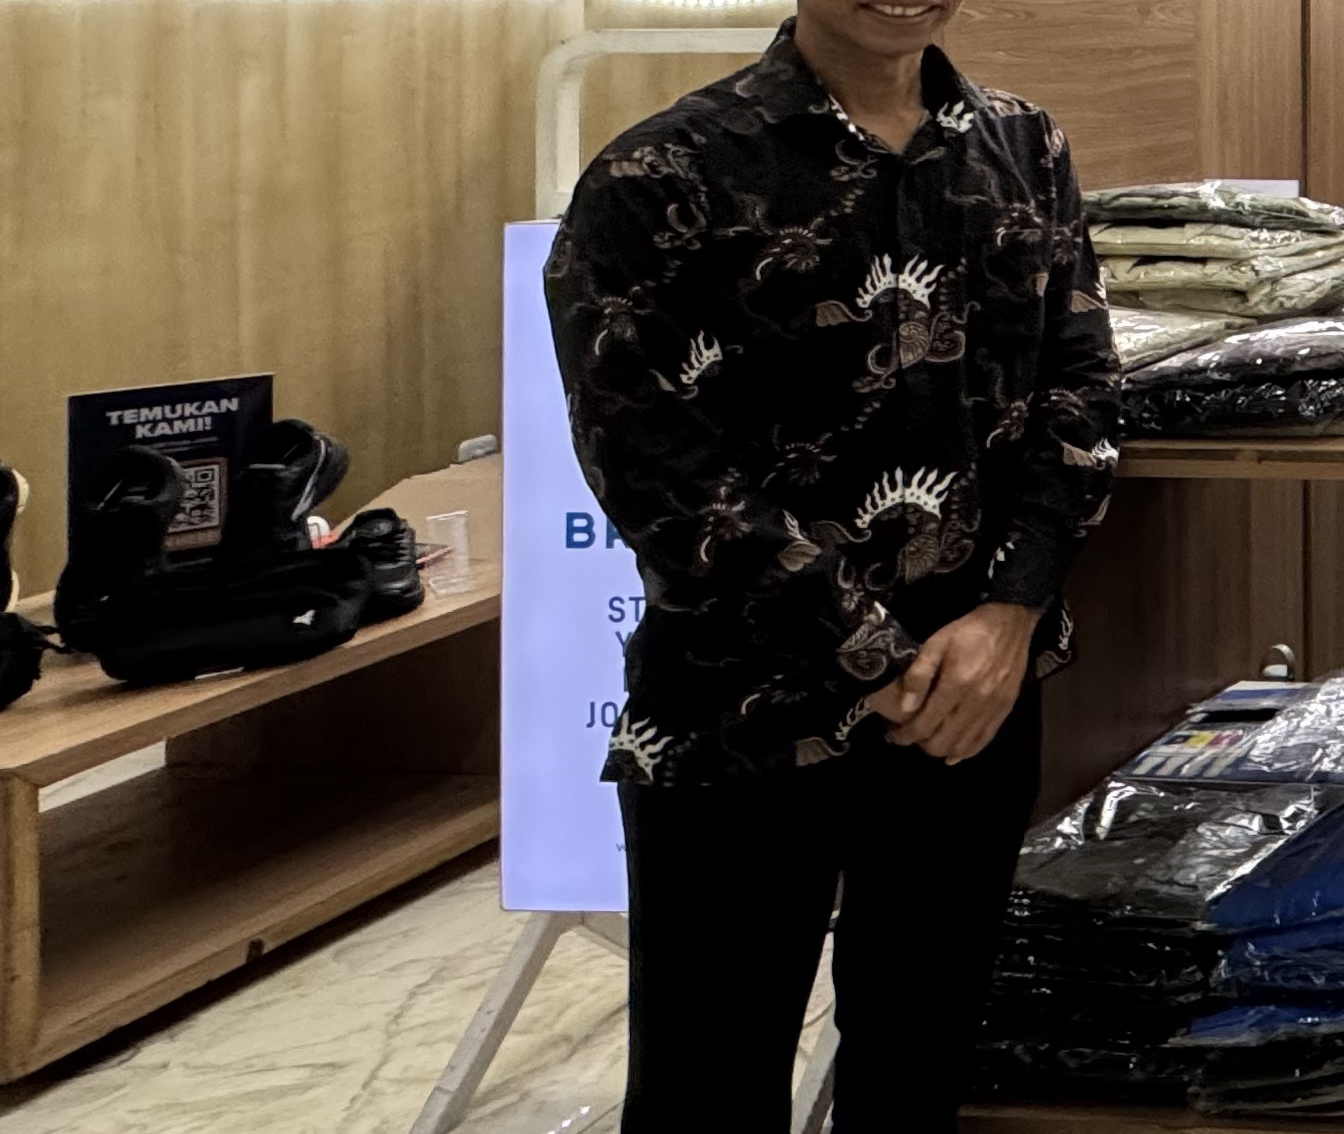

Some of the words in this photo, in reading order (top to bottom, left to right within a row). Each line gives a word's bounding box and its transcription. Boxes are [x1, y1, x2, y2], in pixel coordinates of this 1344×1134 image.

[105, 397, 240, 426] TEMUKAN
[135, 416, 213, 440] KAMI!
[608, 596, 647, 623] ST
[586, 701, 619, 729] JO
